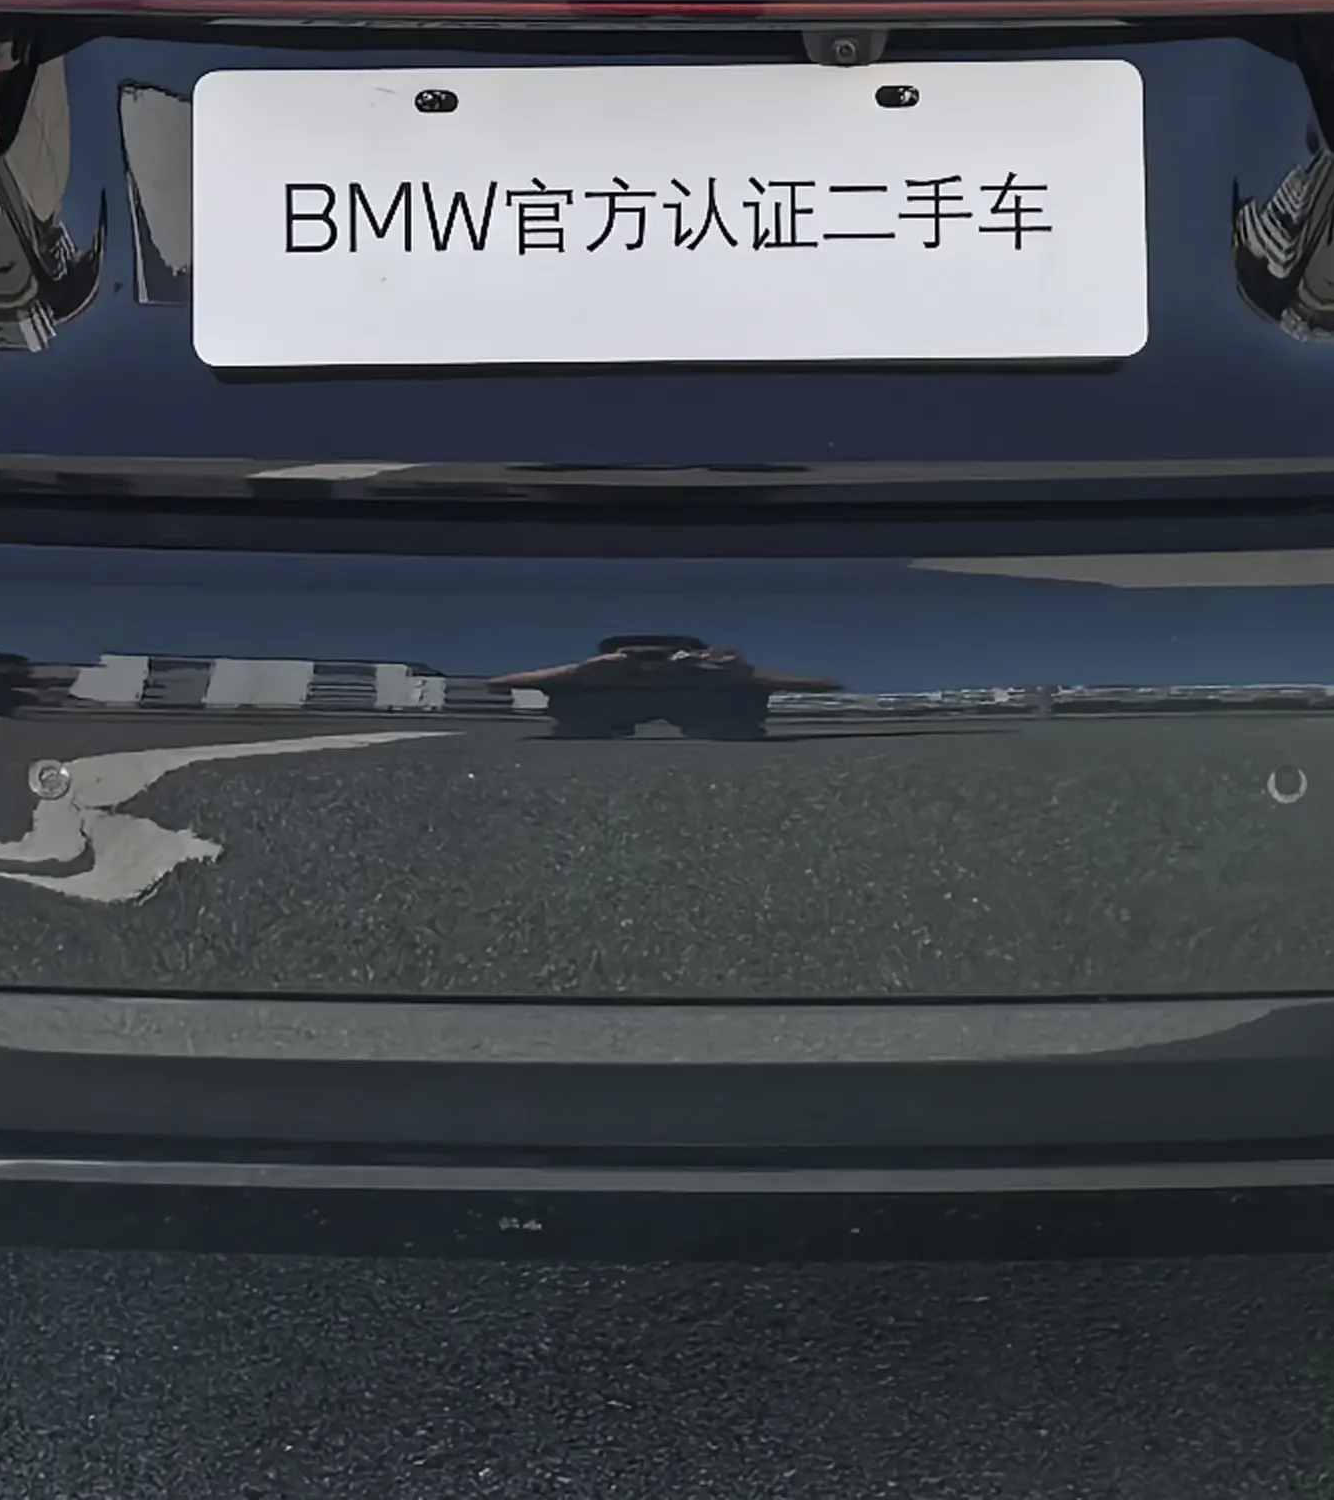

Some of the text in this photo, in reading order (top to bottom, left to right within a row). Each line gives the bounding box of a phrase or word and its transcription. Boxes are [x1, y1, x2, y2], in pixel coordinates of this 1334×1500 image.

[284, 171, 1053, 256] BMW官方认证二手车
